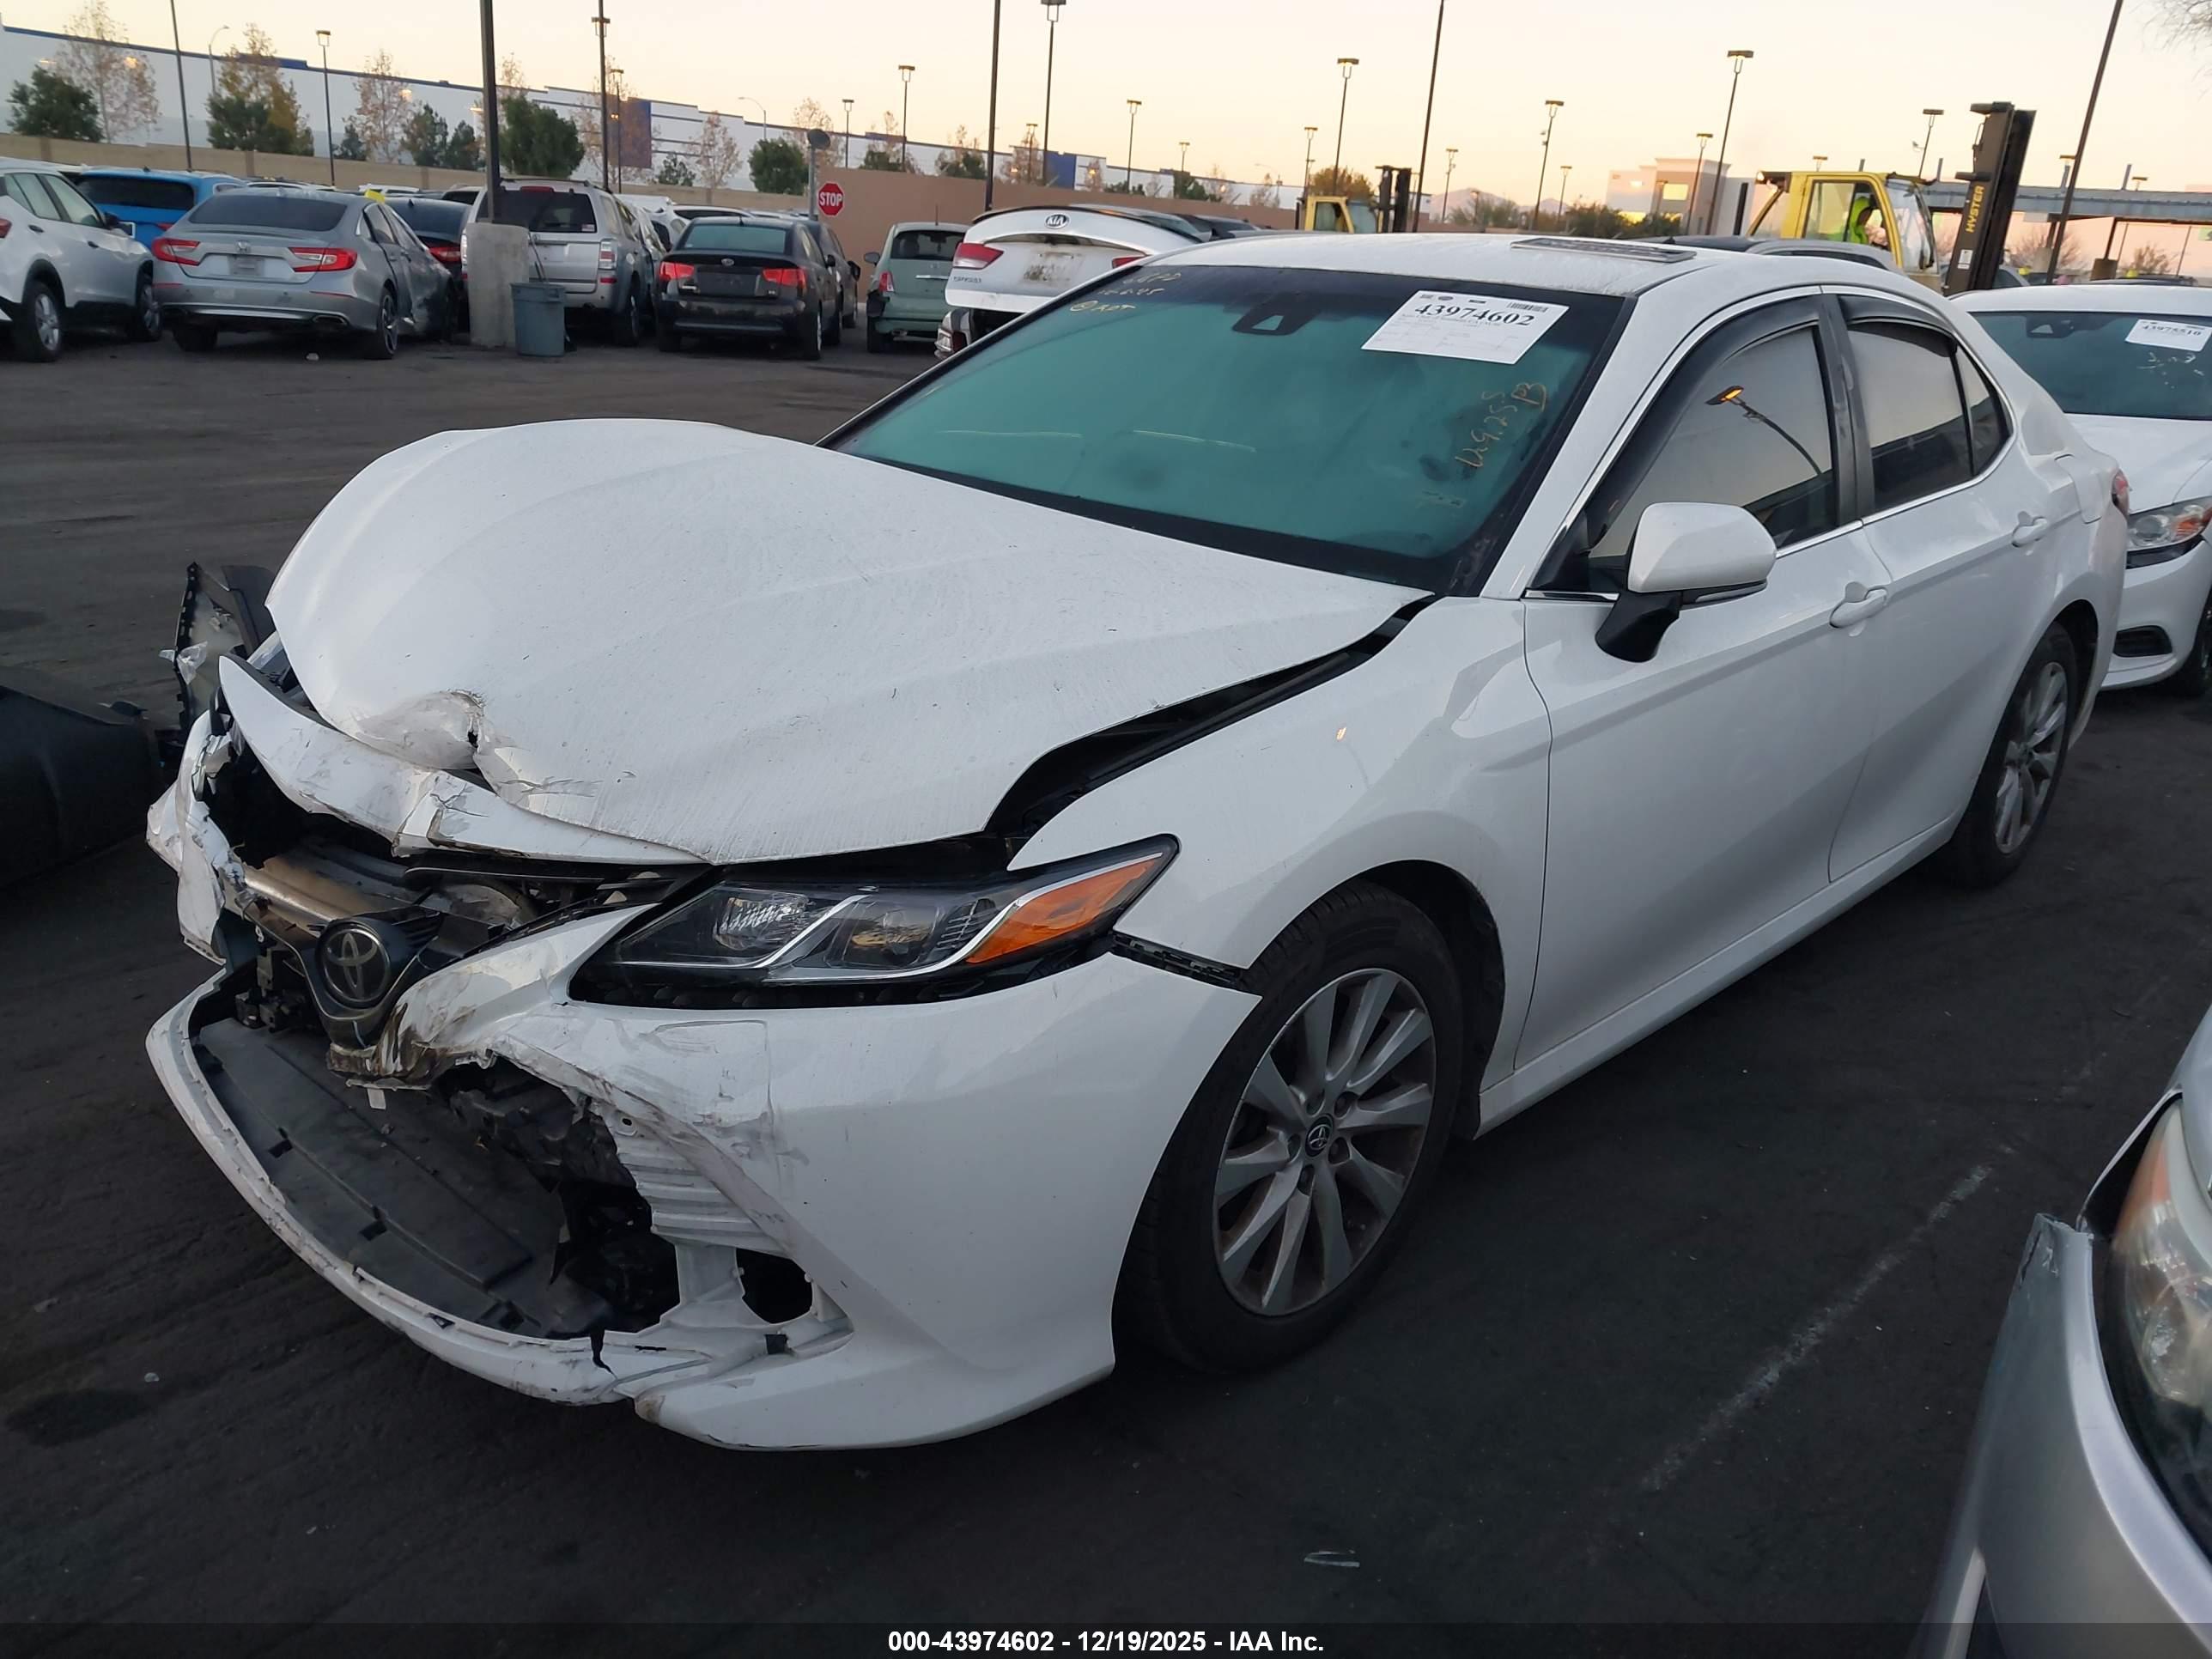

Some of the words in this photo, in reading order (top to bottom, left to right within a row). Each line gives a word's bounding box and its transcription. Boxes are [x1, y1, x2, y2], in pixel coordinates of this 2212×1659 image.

[819, 191, 842, 206] STOP
[1965, 185, 1984, 233] HYSTER
[1046, 215, 1066, 225] KIA
[1414, 303, 1534, 325] 43974602
